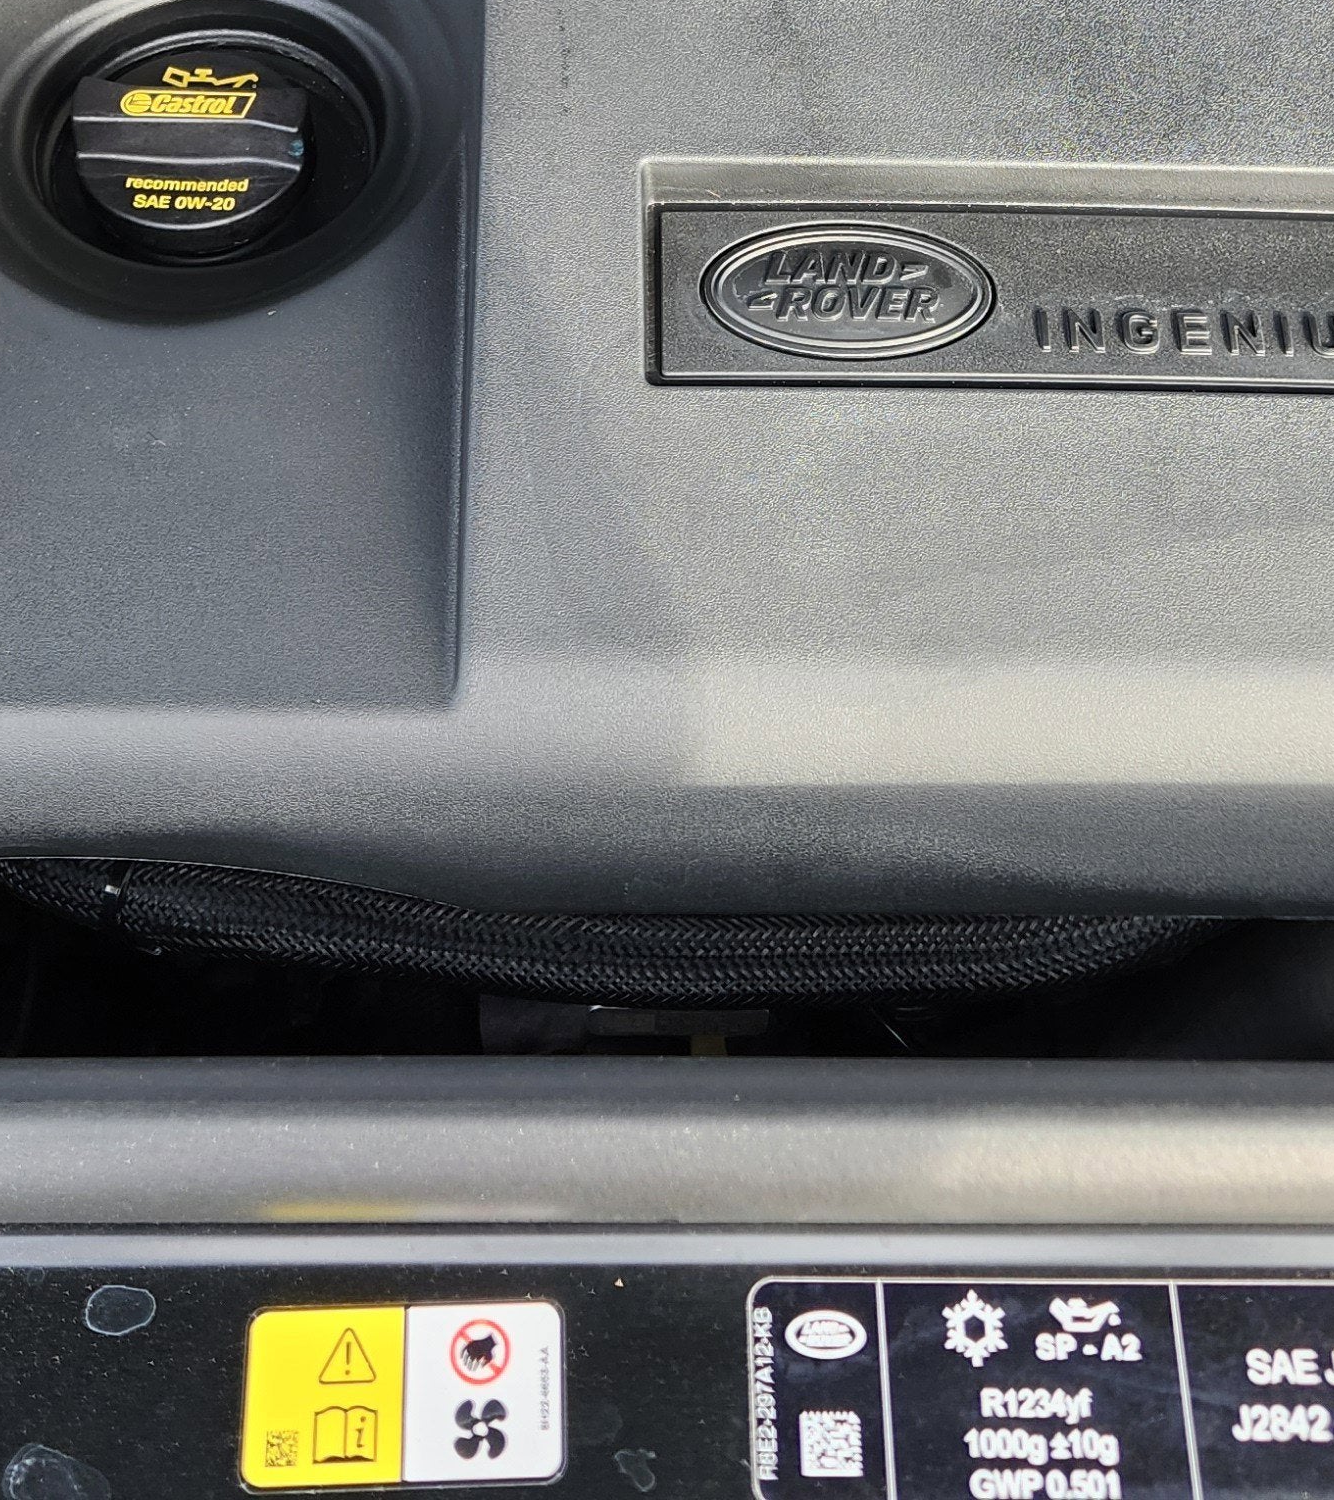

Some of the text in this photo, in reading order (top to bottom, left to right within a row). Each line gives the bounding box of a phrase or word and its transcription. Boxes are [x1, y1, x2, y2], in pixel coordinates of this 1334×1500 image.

[151, 95, 237, 115] Castrol
[125, 175, 250, 192] recommended
[132, 194, 236, 211] SAE 0W-20
[764, 249, 898, 285] LAND
[774, 284, 940, 324] ROVER
[1034, 1332, 1078, 1361] SP
[1100, 1332, 1144, 1362] A2
[1245, 1347, 1322, 1386] SAE
[979, 1386, 1095, 1425] R1234yf
[1231, 1403, 1334, 1442] J2842
[963, 1427, 1121, 1467] 1000g ±10g
[968, 1467, 1123, 1500] GWP 0.501
